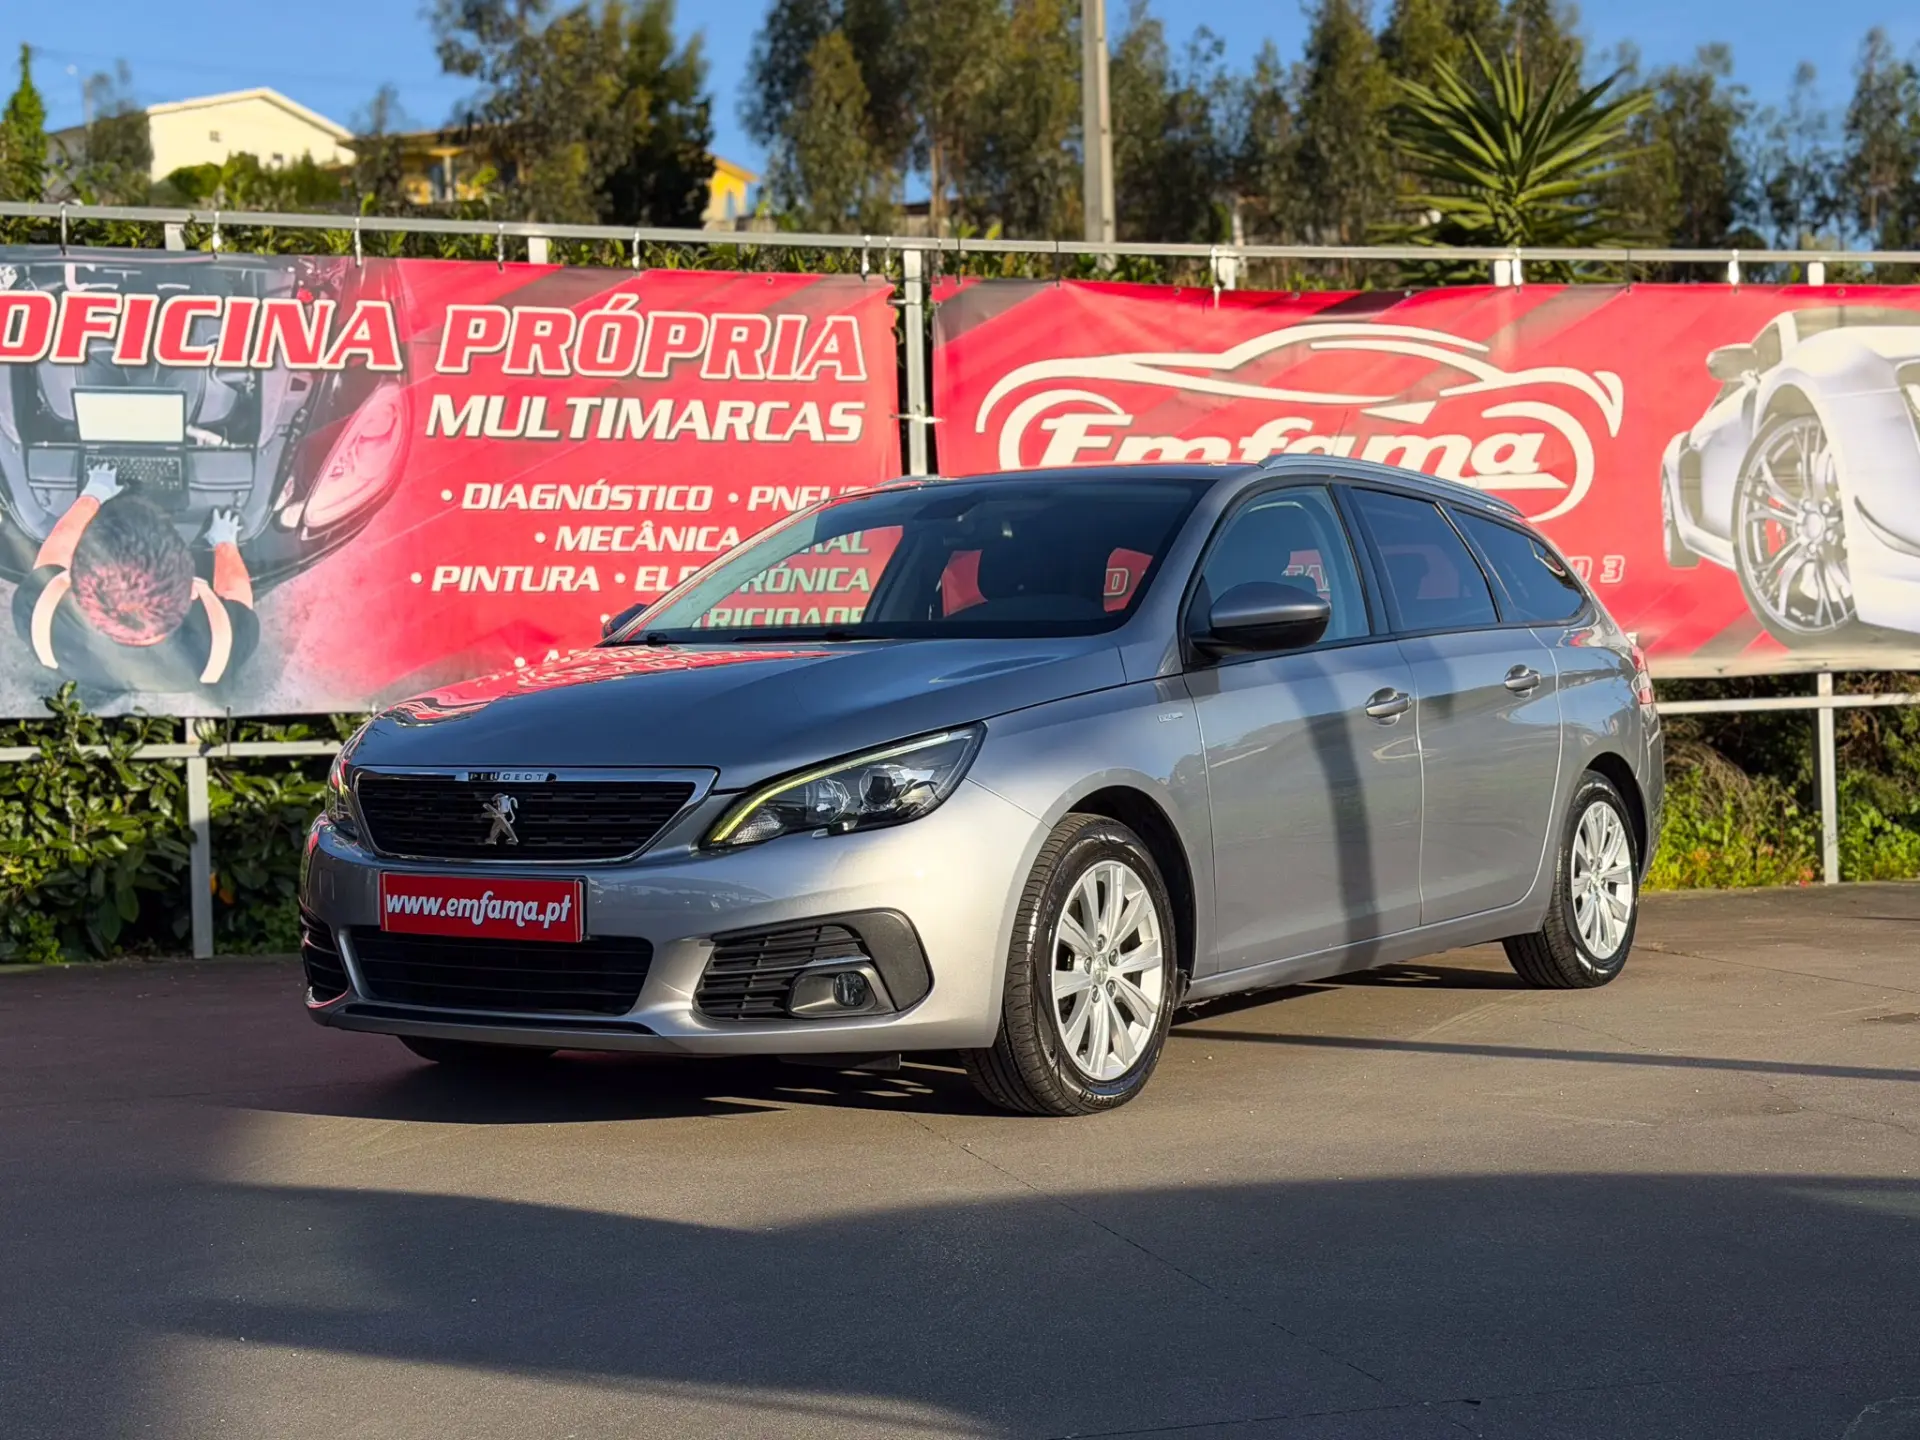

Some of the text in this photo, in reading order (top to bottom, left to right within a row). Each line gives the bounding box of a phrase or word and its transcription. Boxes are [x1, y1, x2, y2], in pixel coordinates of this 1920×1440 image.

[0, 291, 867, 382] OFICINA PRÓPRIA
[425, 394, 865, 443] MULTIMARCAS
[462, 479, 713, 511] DIAGNÓSTICO
[555, 521, 740, 552] MECÂNICA
[432, 565, 600, 593] PINTURA
[469, 772, 544, 781] PEUGEOT
[386, 890, 572, 929] www.emfama.pt
